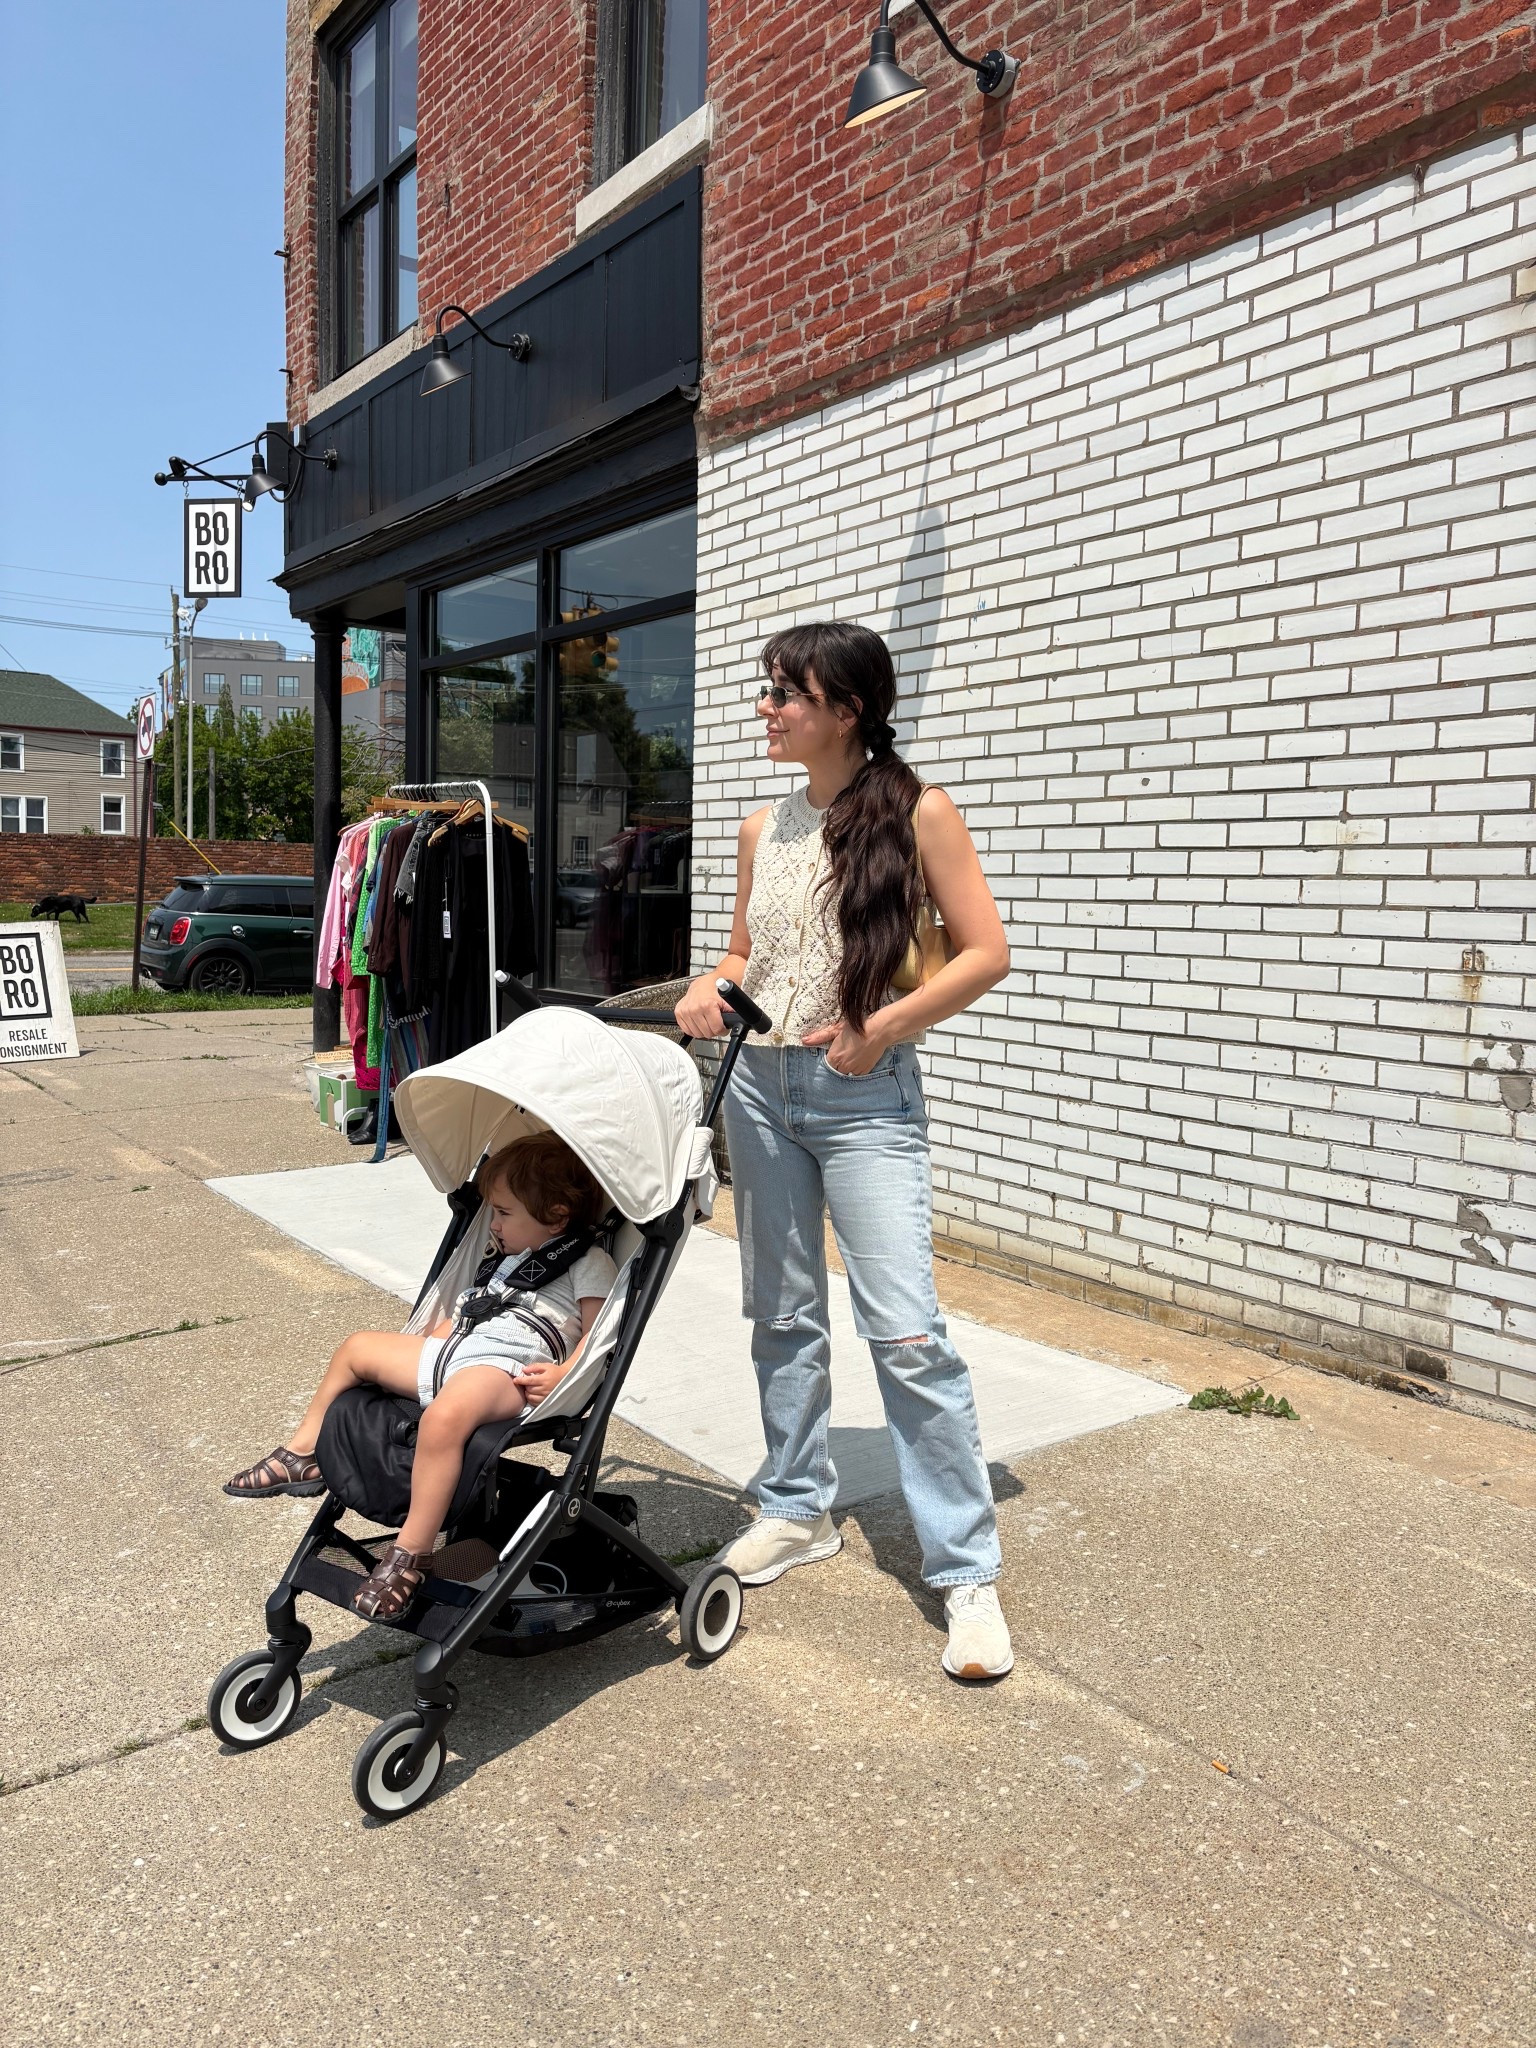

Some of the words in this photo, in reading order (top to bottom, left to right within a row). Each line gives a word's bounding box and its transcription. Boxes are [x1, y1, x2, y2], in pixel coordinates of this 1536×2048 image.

[195, 511, 229, 546] BO
[195, 550, 229, 585] RO
[0, 944, 34, 974] BO
[3, 978, 39, 1009] RO
[8, 1028, 48, 1042] RESALE
[0, 1042, 68, 1059] ONSIGNMENT
[556, 1238, 580, 1255] cybex
[612, 1598, 631, 1608] cybex
